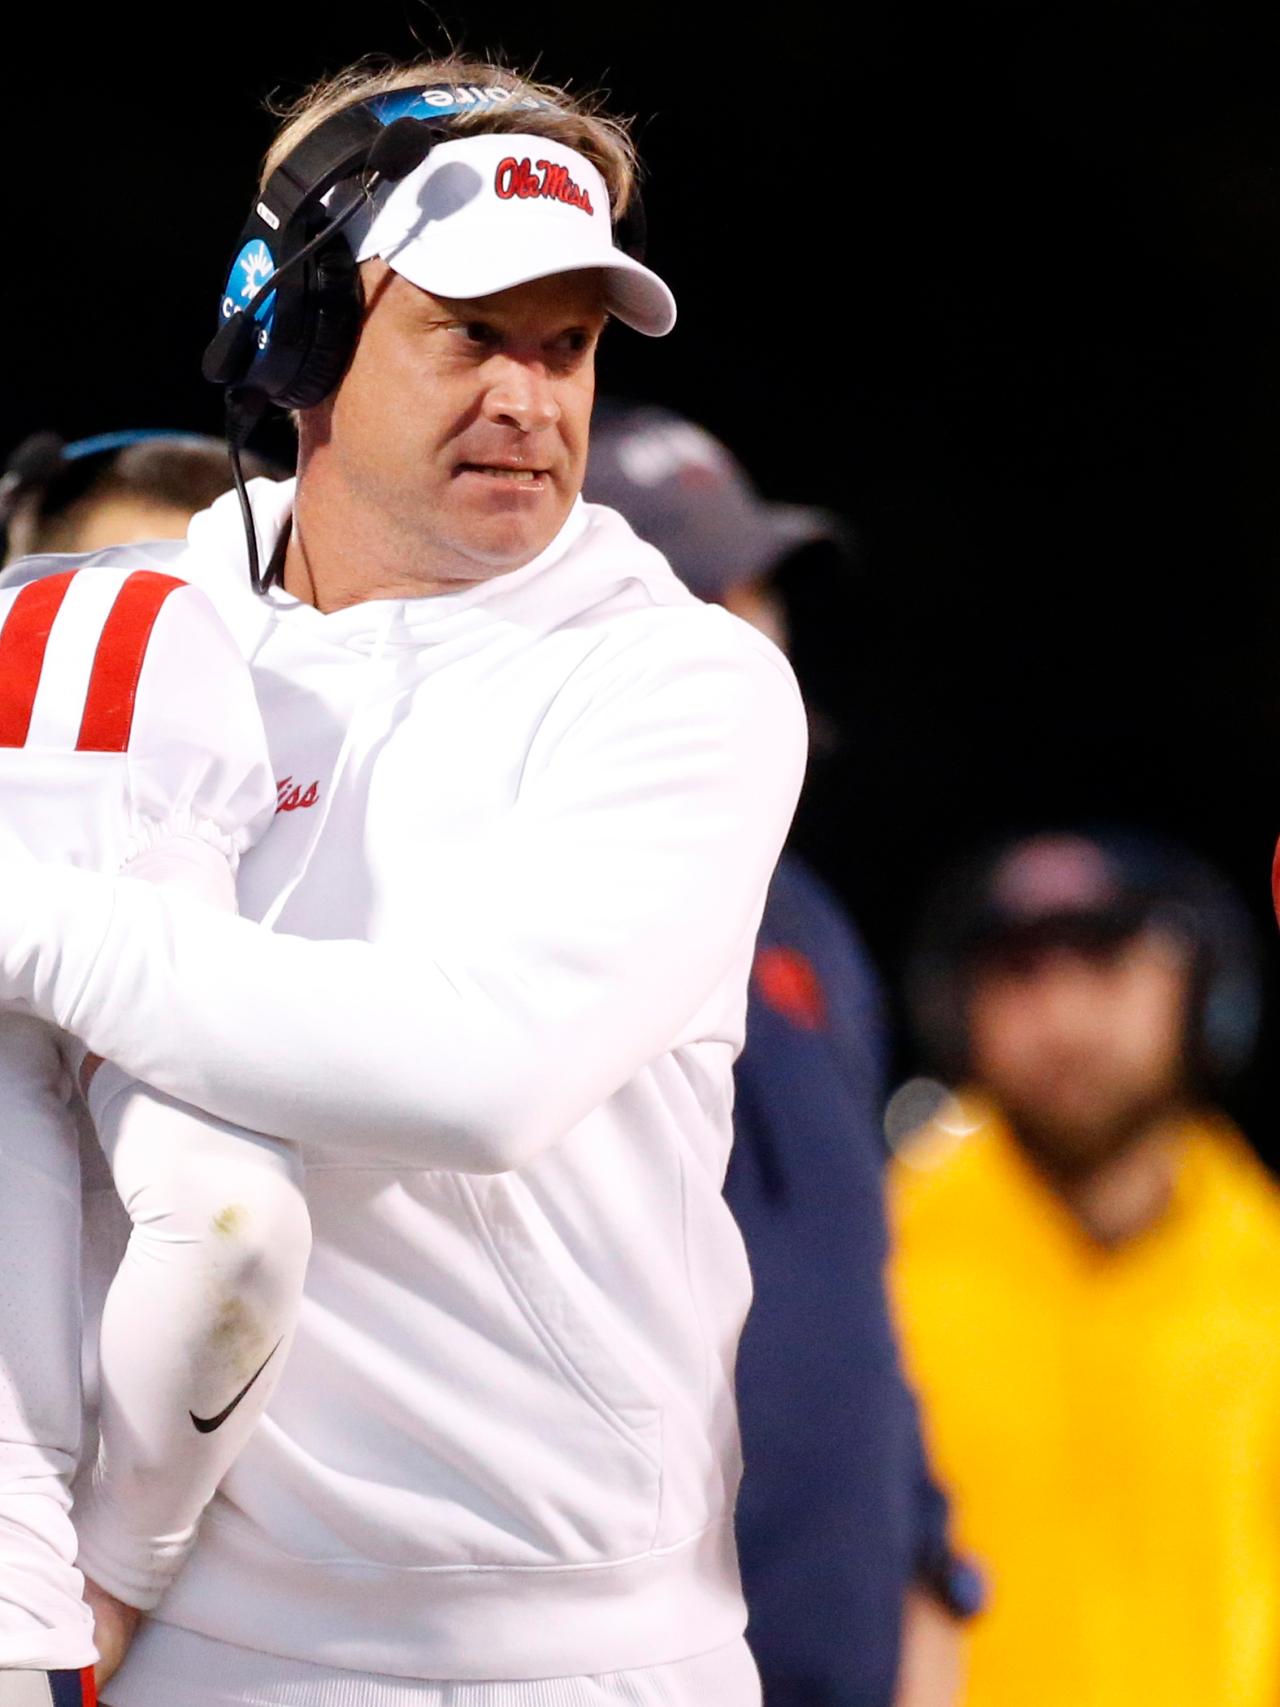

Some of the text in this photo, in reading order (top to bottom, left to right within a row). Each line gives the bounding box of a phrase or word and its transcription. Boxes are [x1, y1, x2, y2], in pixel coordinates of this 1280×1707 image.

[494, 156, 594, 216] Ole Miss
[275, 775, 320, 815] iss
